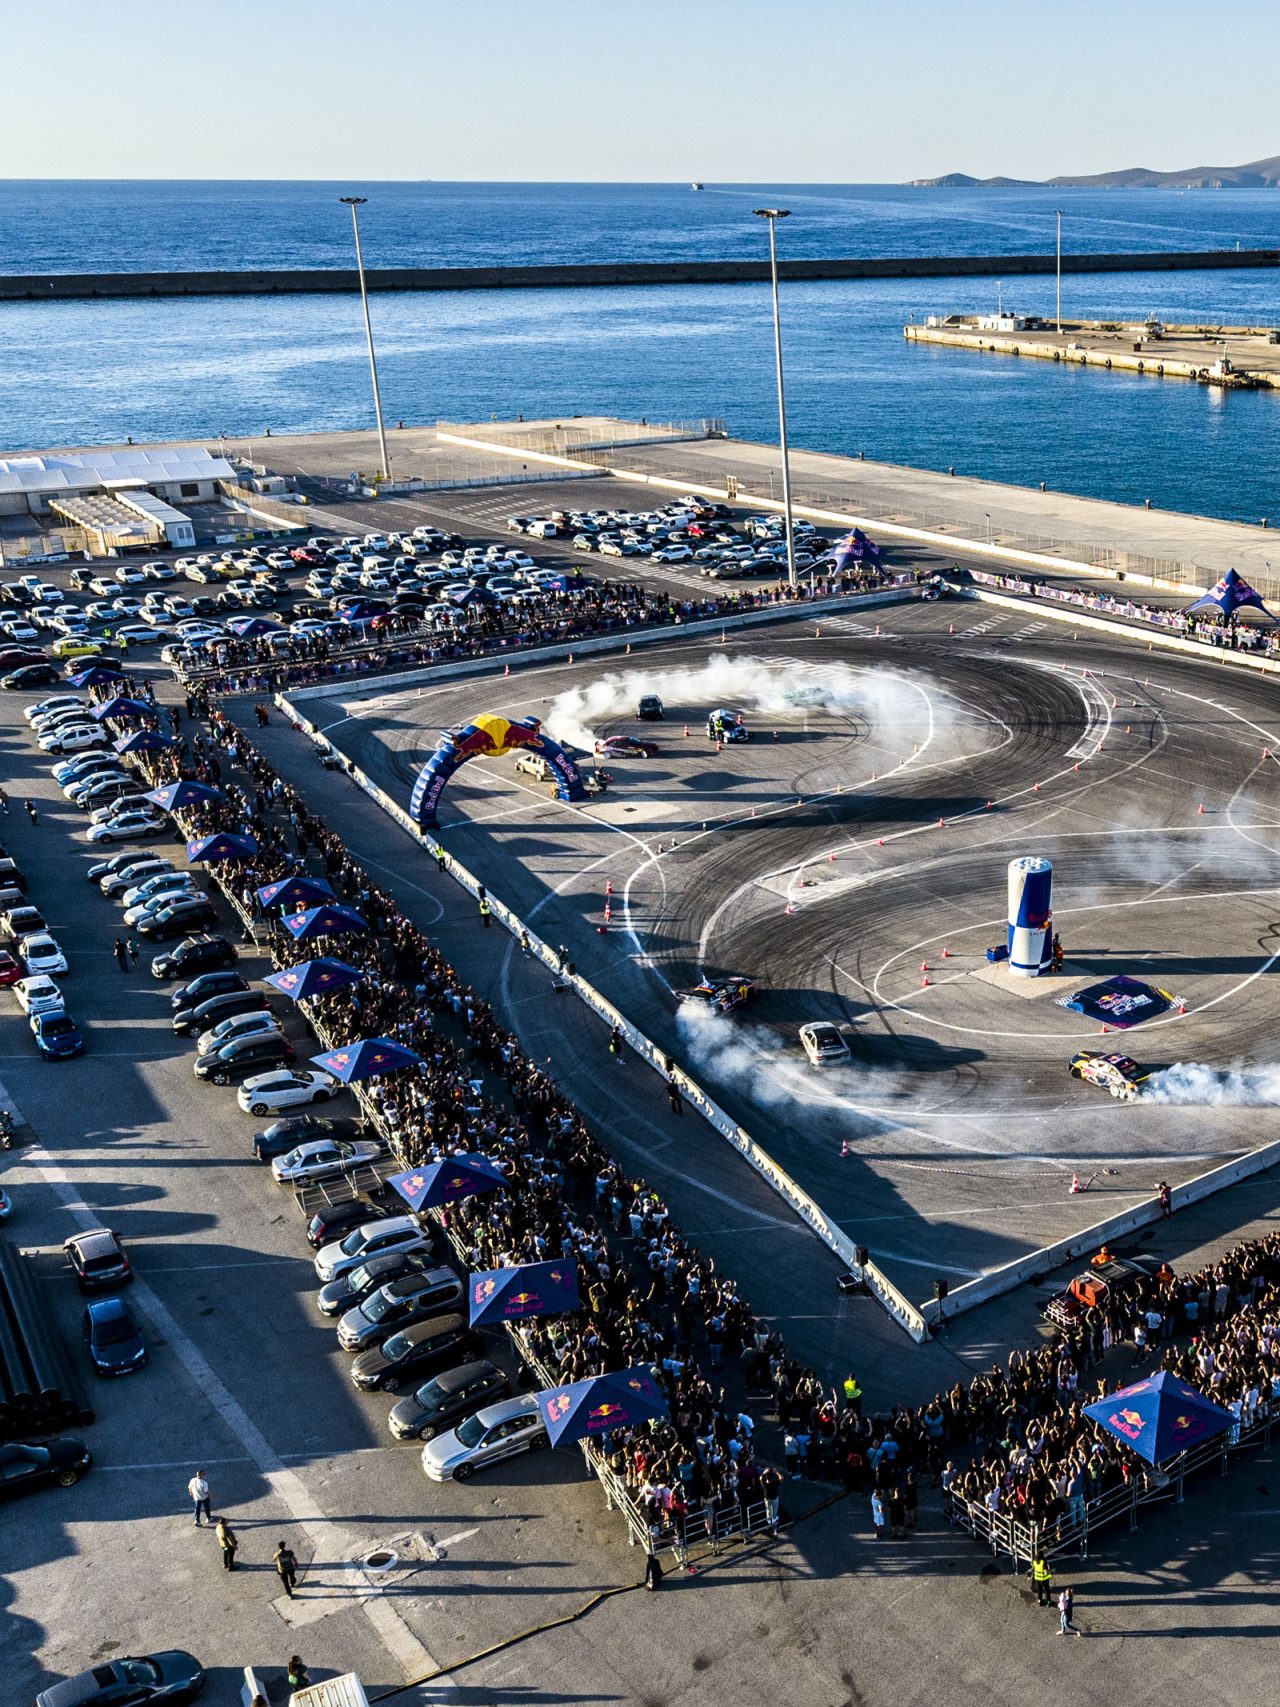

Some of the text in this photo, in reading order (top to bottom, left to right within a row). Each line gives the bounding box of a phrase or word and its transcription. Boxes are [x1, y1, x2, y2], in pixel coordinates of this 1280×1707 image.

[425, 776, 445, 809] Red Bull
[505, 1301, 544, 1314] Red Bull
[587, 1412, 628, 1430] Red Bull
[1109, 1414, 1141, 1440] Red Bull
